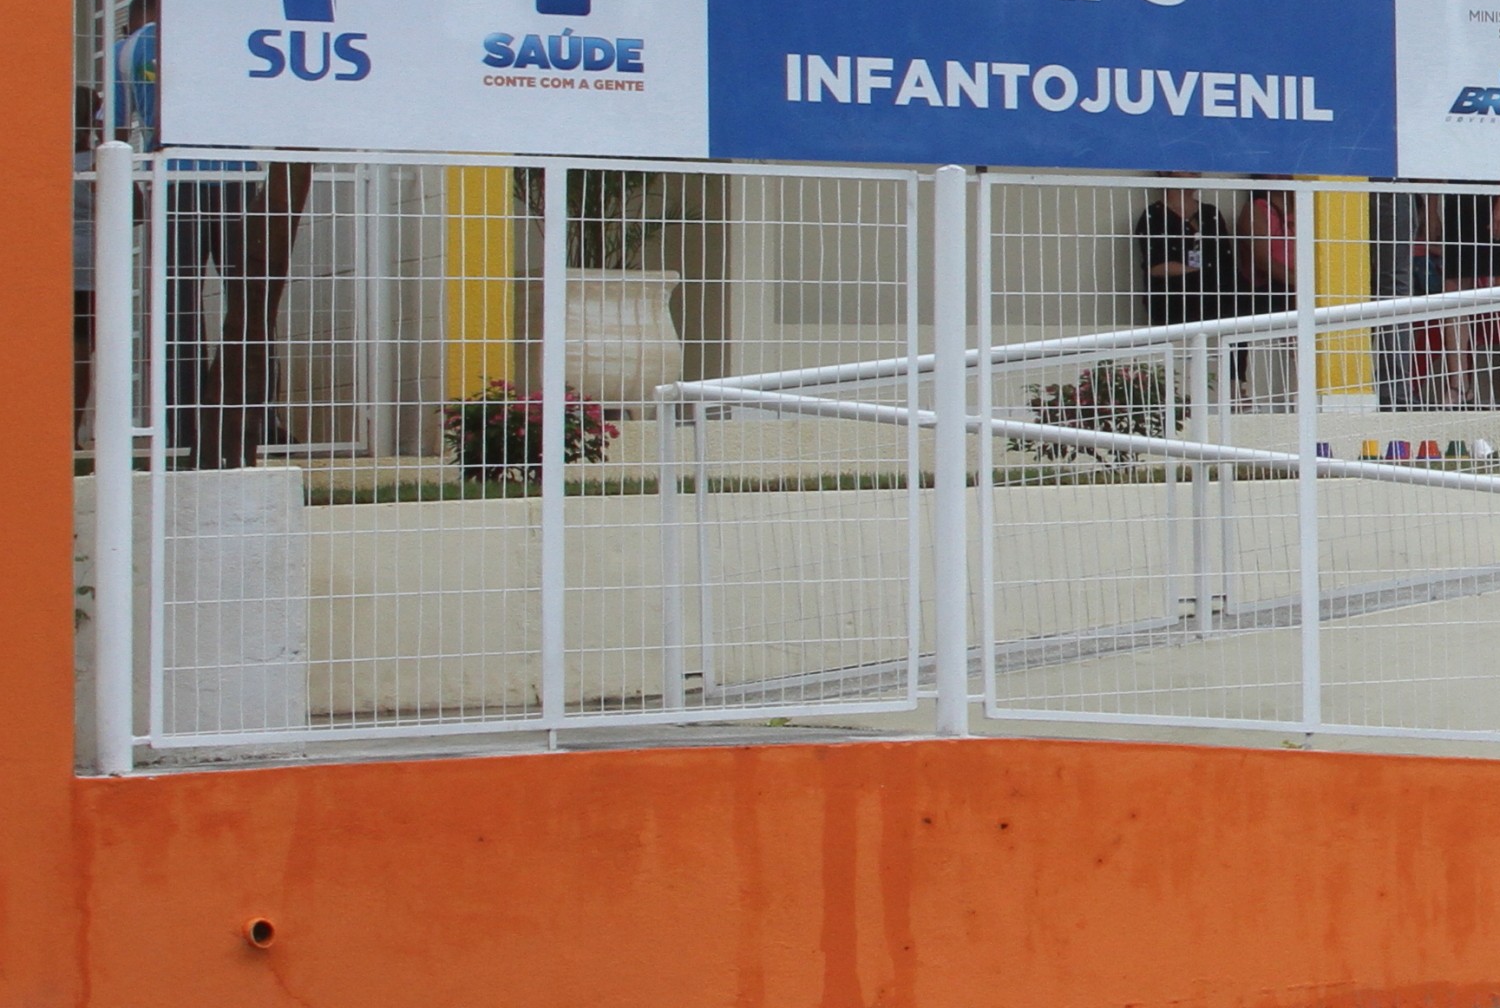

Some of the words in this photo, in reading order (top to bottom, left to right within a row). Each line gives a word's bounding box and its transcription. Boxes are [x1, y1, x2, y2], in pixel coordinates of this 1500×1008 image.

[247, 28, 372, 81] SUS
[482, 27, 645, 73] SAÚDE
[483, 75, 536, 88] CONTE
[540, 77, 574, 89] COM
[578, 79, 590, 89] A
[593, 79, 645, 92] GENTE
[785, 52, 1335, 122] INFANTOJUVENIL
